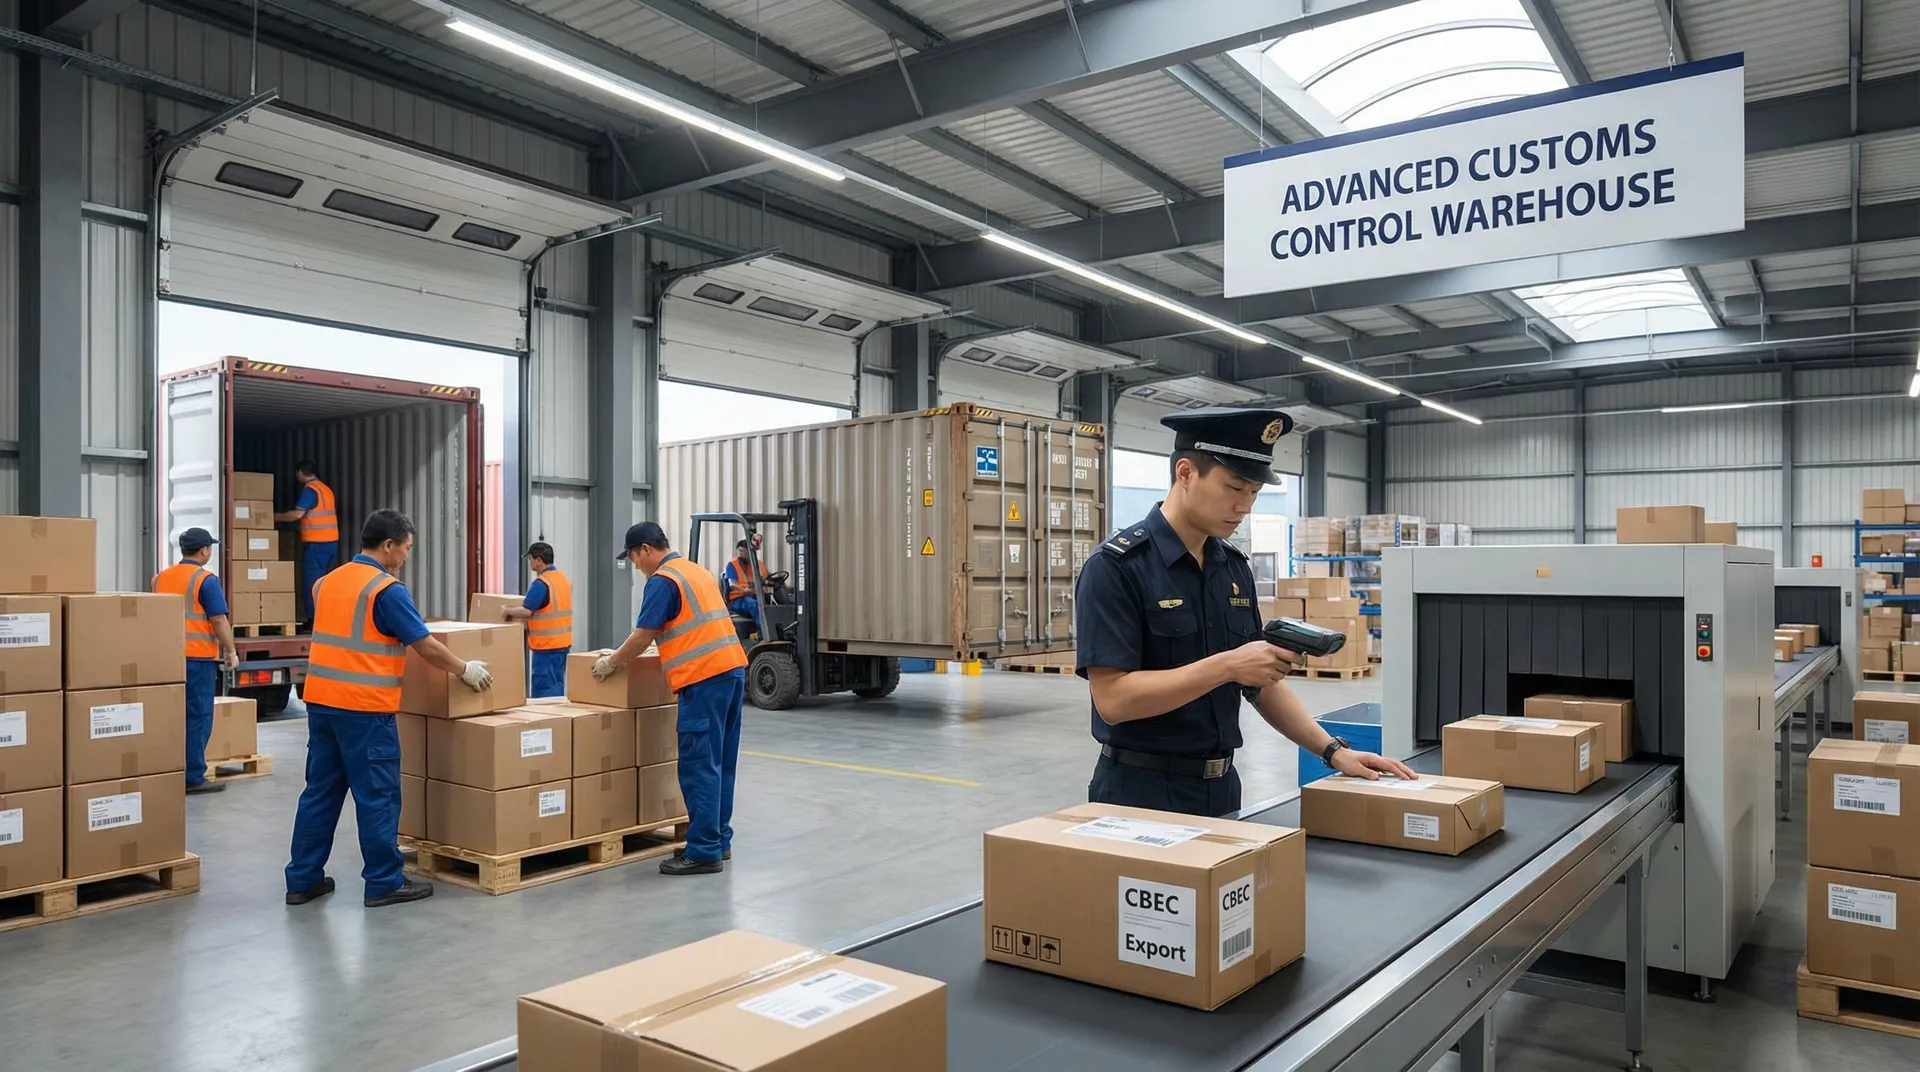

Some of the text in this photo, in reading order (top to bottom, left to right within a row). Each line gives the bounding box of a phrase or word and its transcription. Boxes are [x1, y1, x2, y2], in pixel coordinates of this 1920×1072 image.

[1281, 118, 1657, 215] ADVANCED CUSTOMS
[1270, 167, 1676, 260] CONTROL WAREHOUSE
[1125, 888, 1179, 914] CBEC
[1222, 884, 1250, 911] CBEC
[1126, 933, 1186, 962] Export
